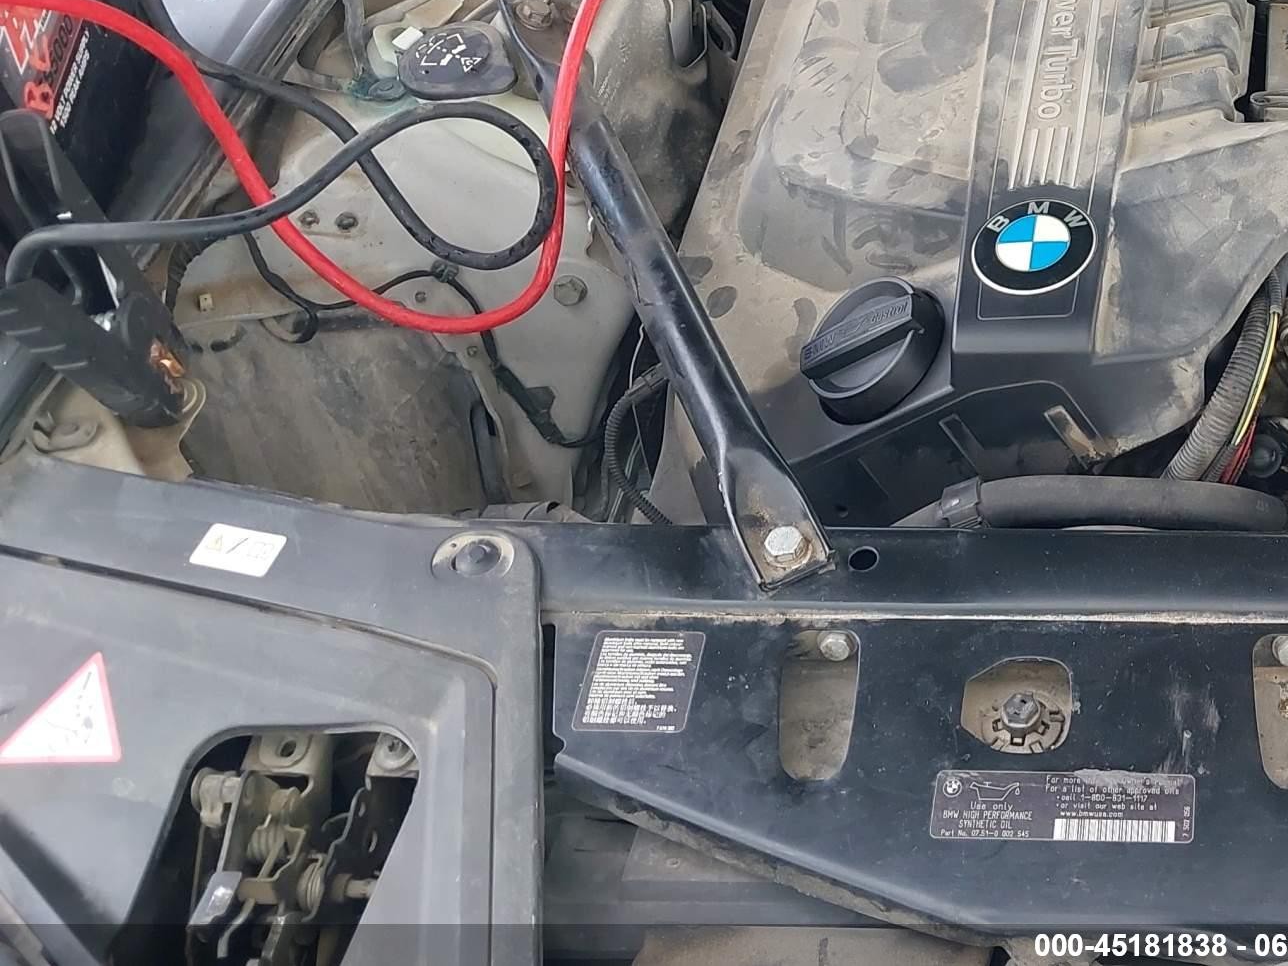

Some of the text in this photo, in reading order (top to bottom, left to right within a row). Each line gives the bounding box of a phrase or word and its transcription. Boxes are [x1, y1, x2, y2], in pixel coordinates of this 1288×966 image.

[54, 95, 66, 121] VOLT
[63, 61, 78, 99] POWER
[75, 27, 90, 64] SUPPLY
[69, 77, 81, 105] PEAK
[78, 49, 90, 80] AMPS
[1037, 38, 1079, 120] Turbo
[987, 201, 1088, 233] BMW
[804, 301, 909, 361] BMW Castrol
[1045, 785, 1060, 793] For
[1071, 785, 1085, 793] list
[1089, 786, 1098, 794] of
[1102, 786, 1122, 794] other
[1126, 787, 1160, 796] approved
[1164, 787, 1180, 795] oils
[970, 801, 1014, 812] Use only
[1130, 803, 1145, 811] site
[1149, 803, 1158, 811] at
[942, 810, 1033, 821] BMW HIGH PERFORMANCE
[1060, 810, 1124, 818] www.bmwusa.com
[958, 819, 1013, 829] SYNTHETIC OIL
[940, 828, 955, 836] Part
